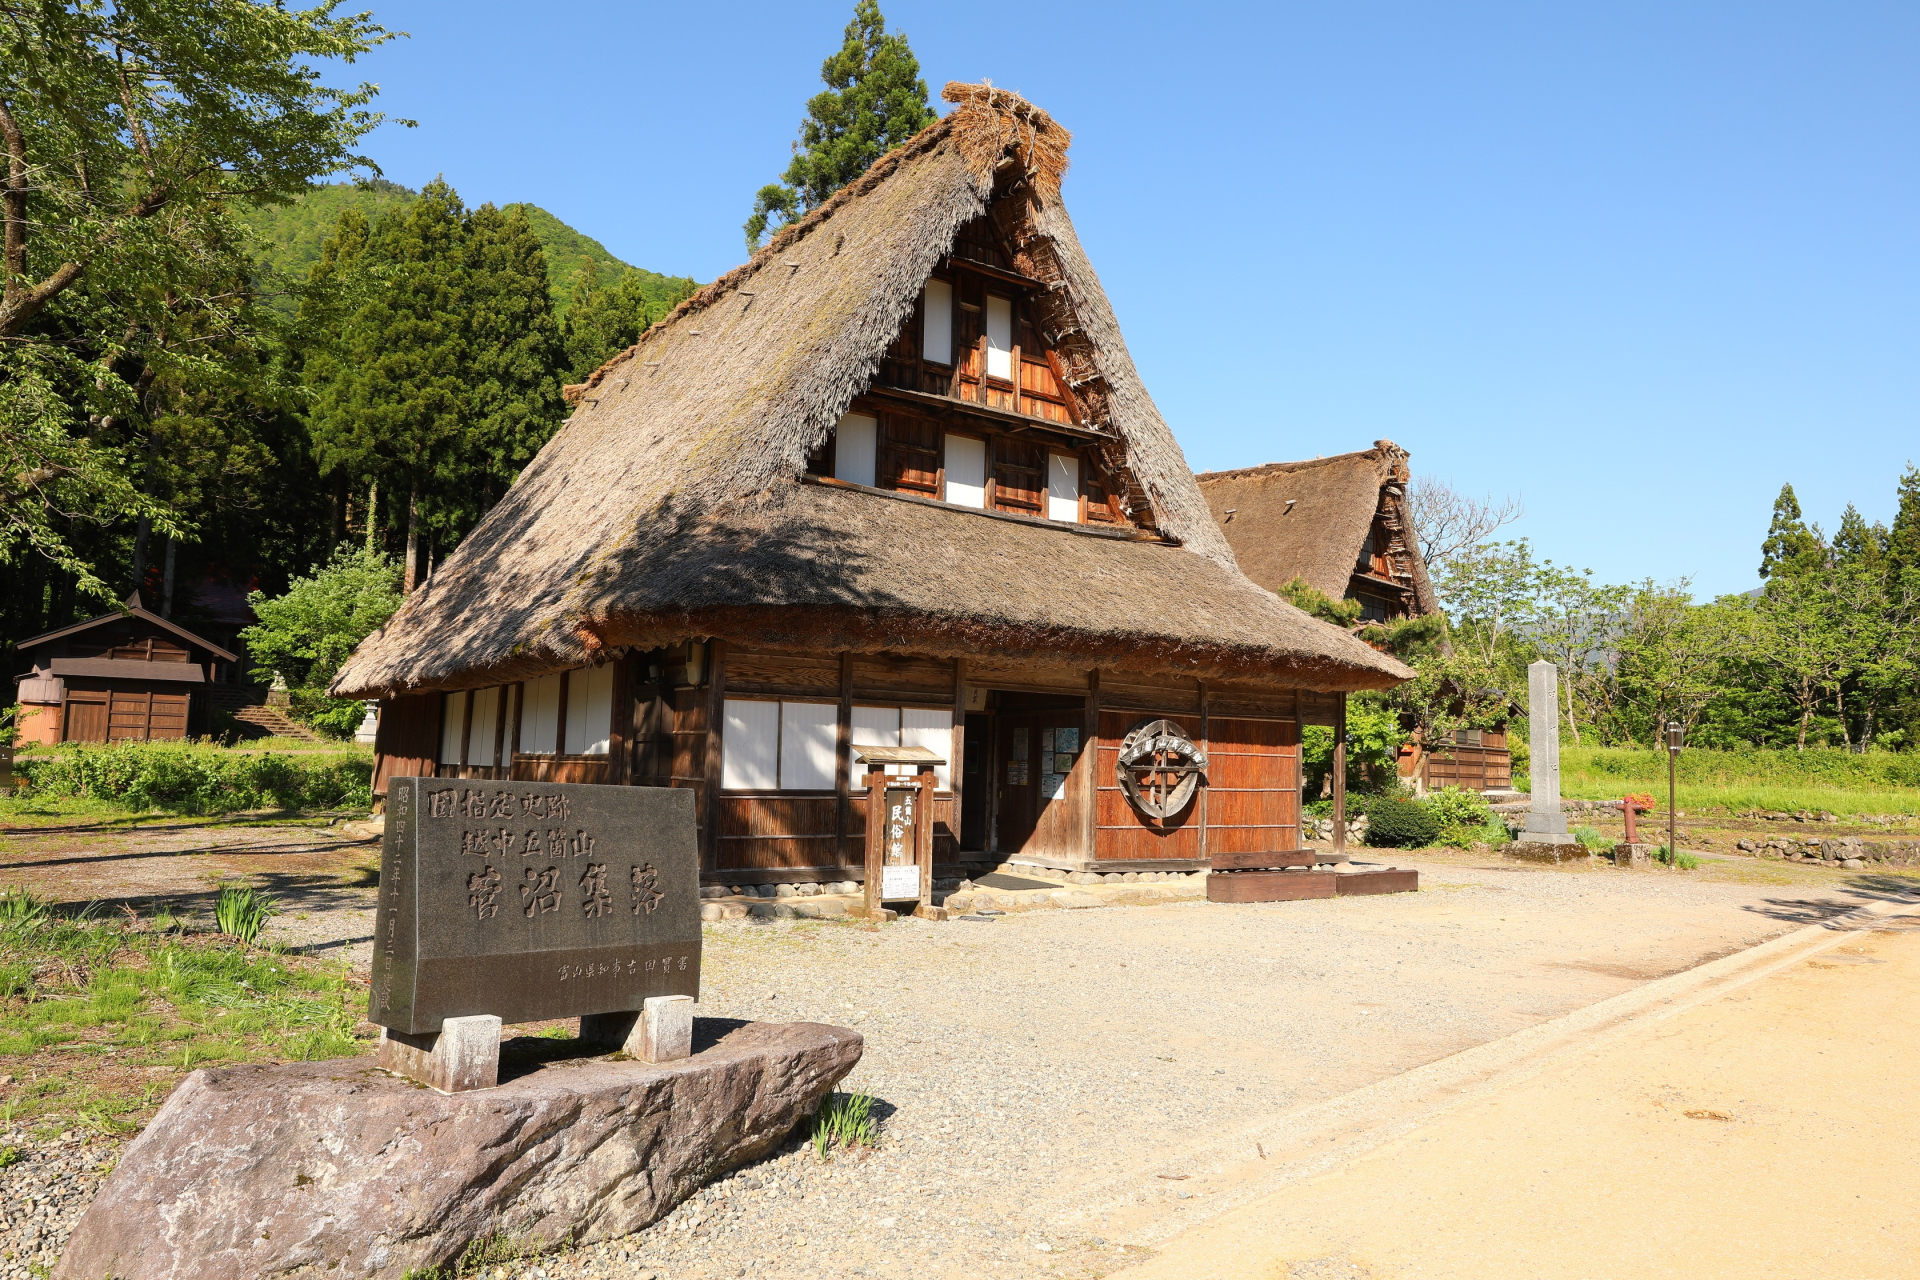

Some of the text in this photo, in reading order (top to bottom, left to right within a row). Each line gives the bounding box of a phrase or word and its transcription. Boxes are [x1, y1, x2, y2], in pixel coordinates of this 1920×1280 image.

[461, 828, 595, 858] 越中五箇山
[891, 804, 904, 858] 民俗館
[467, 863, 664, 920] 菅沼集落
